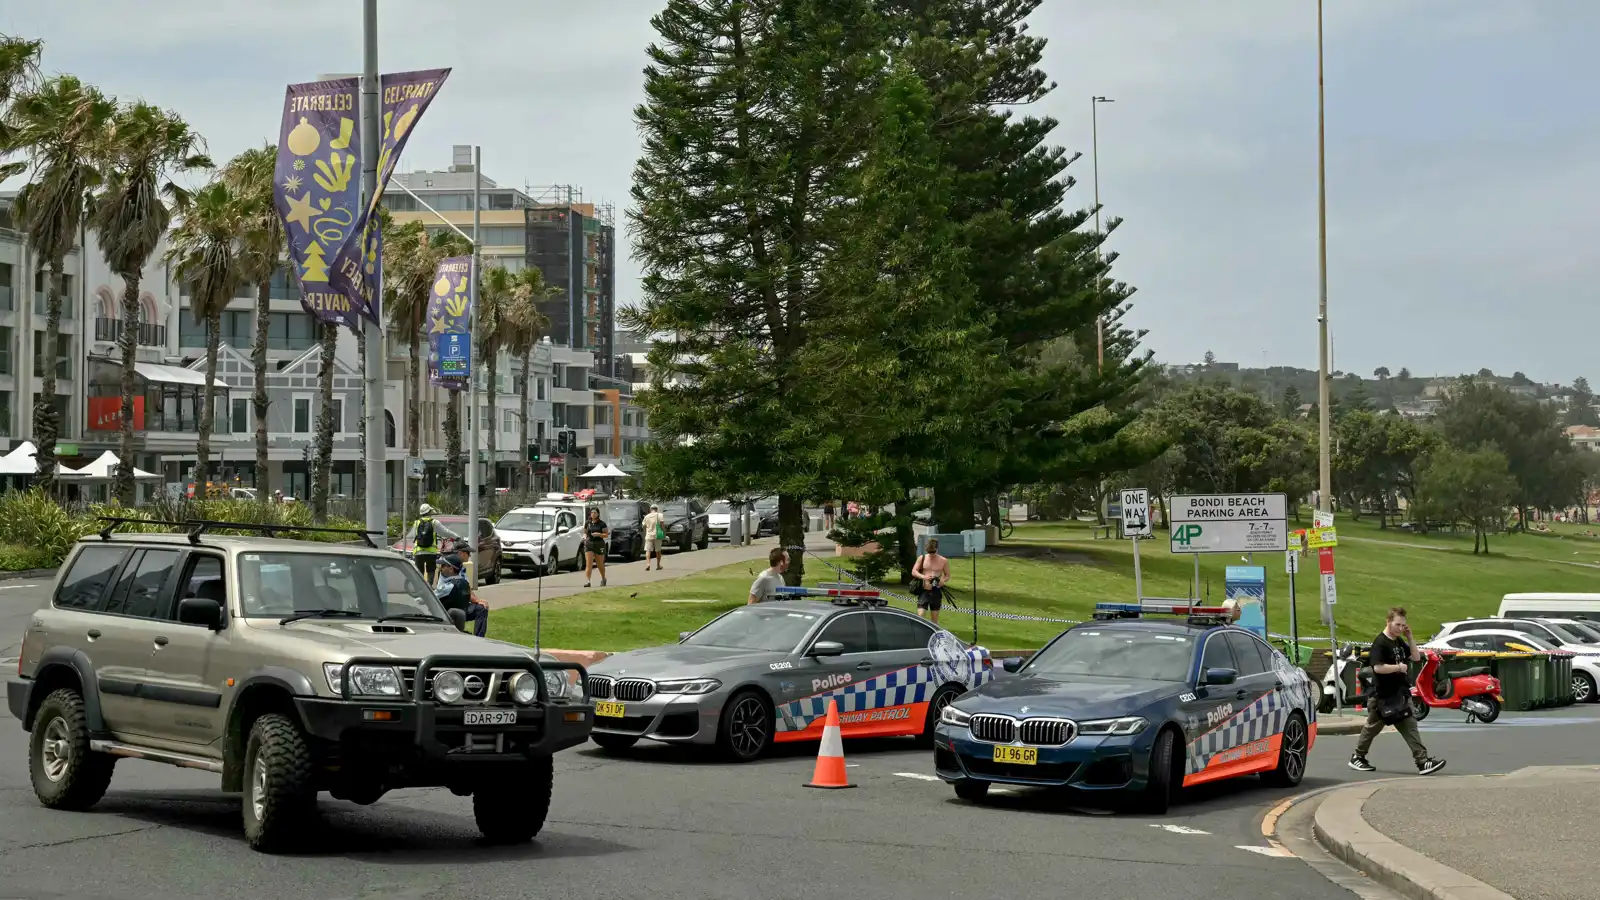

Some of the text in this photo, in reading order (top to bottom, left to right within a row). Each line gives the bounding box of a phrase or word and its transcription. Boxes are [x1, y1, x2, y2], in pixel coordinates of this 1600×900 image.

[1125, 493, 1145, 504] ONE
[1190, 497, 1265, 507] BONDI BEACH
[1125, 507, 1146, 519] WAY
[1187, 508, 1269, 518] PARKING AREA
[1172, 524, 1203, 545] 4P
[769, 661, 793, 670] CE202
[812, 673, 852, 692] Police
[870, 707, 910, 721] PATROL
[1207, 702, 1233, 727] Police
[995, 747, 1036, 761] DI 96 GR
